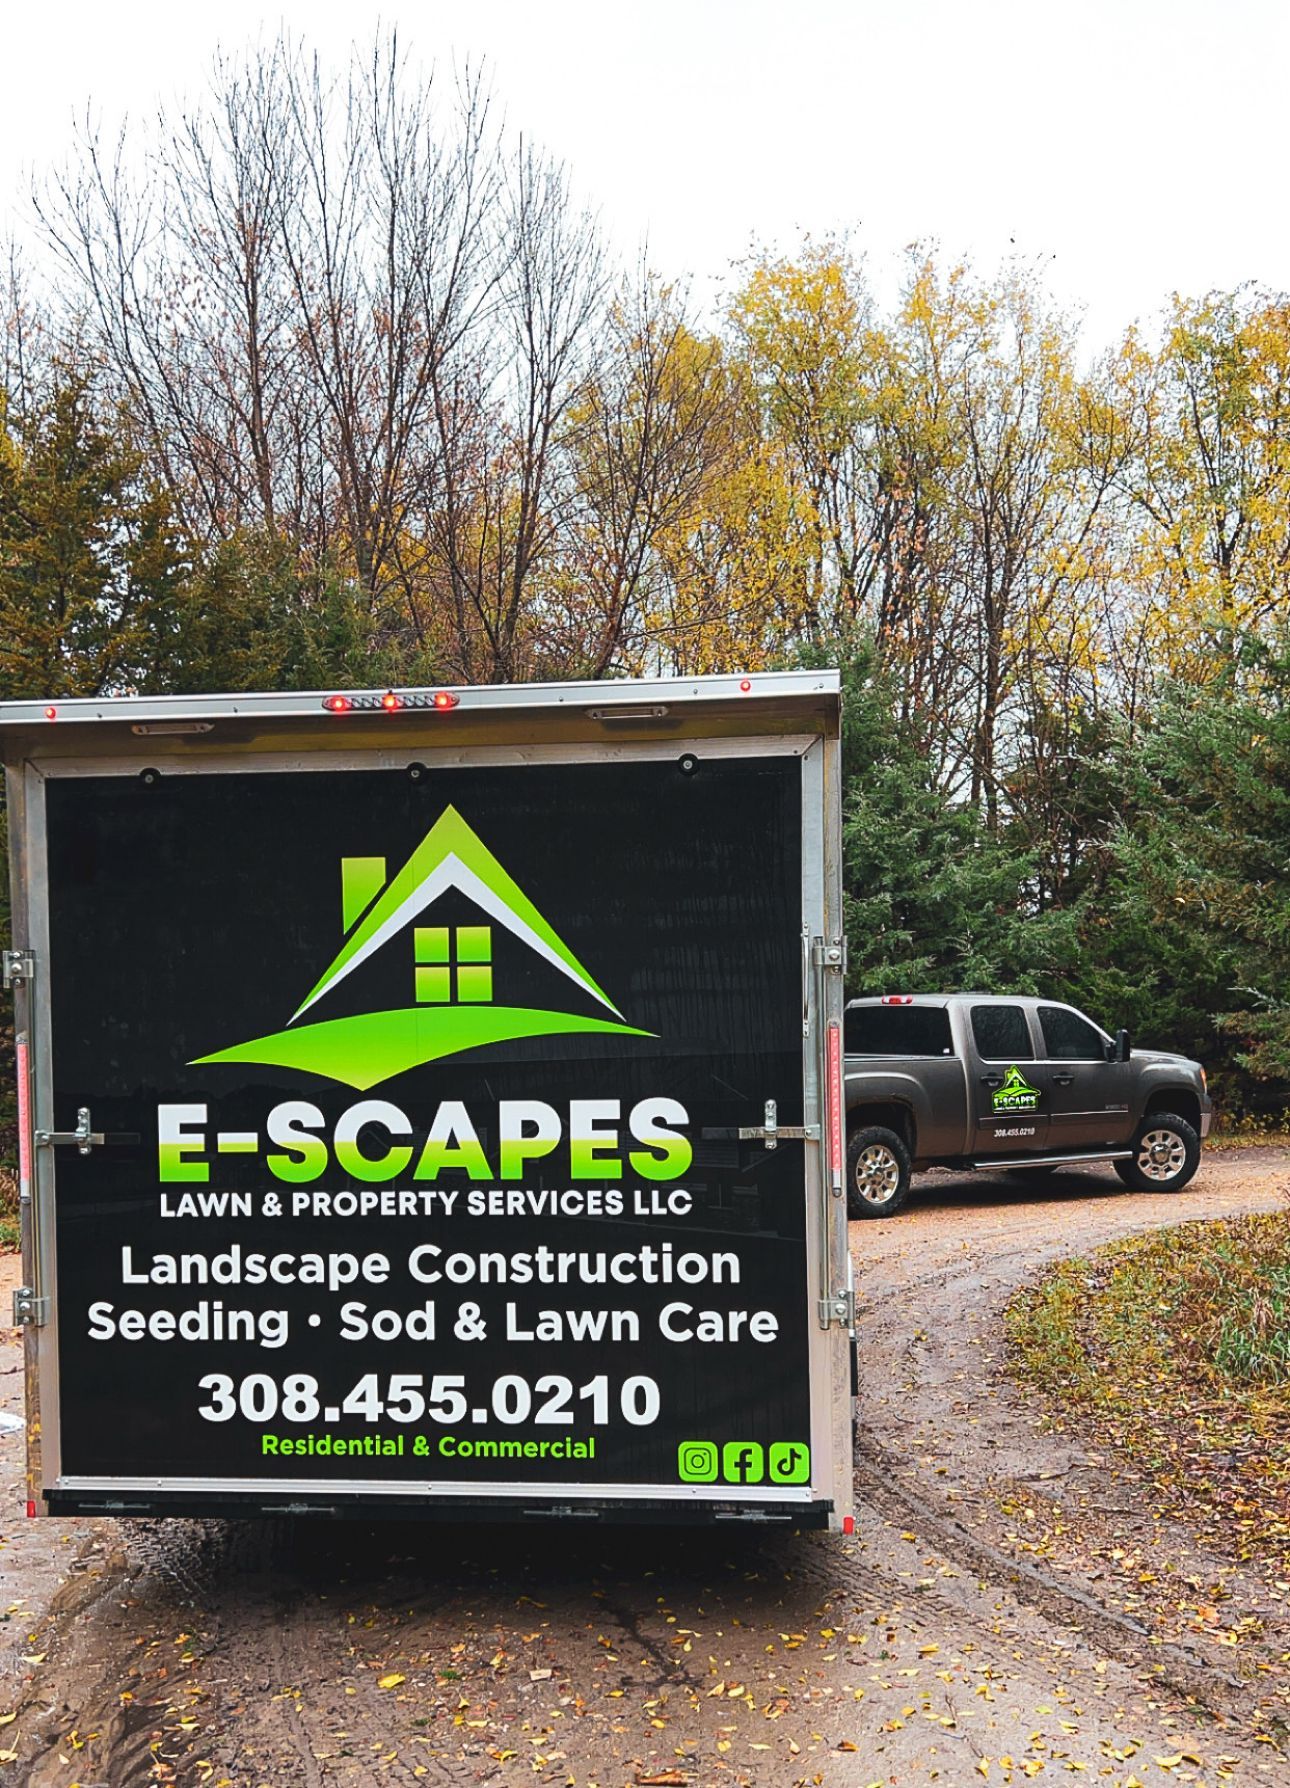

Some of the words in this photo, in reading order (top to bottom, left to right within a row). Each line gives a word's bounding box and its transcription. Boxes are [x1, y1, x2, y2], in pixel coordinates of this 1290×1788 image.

[158, 1097, 693, 1182] E-SCAPES
[160, 1192, 252, 1218] LAWN
[261, 1192, 283, 1217] &
[292, 1190, 459, 1217] PROPERTY
[467, 1189, 624, 1216] SERVICES
[634, 1189, 693, 1216] LLC
[121, 1244, 391, 1292] Landscape
[408, 1242, 740, 1284] Construction
[87, 1300, 289, 1349] Seeding
[339, 1300, 436, 1341] Sod
[453, 1301, 487, 1341] &
[506, 1302, 640, 1342] Lawn
[658, 1301, 779, 1343] Care
[198, 1373, 661, 1426] 308.455.0210
[262, 1434, 404, 1456] Residential
[412, 1435, 430, 1457] &
[438, 1436, 595, 1459] Commercial
